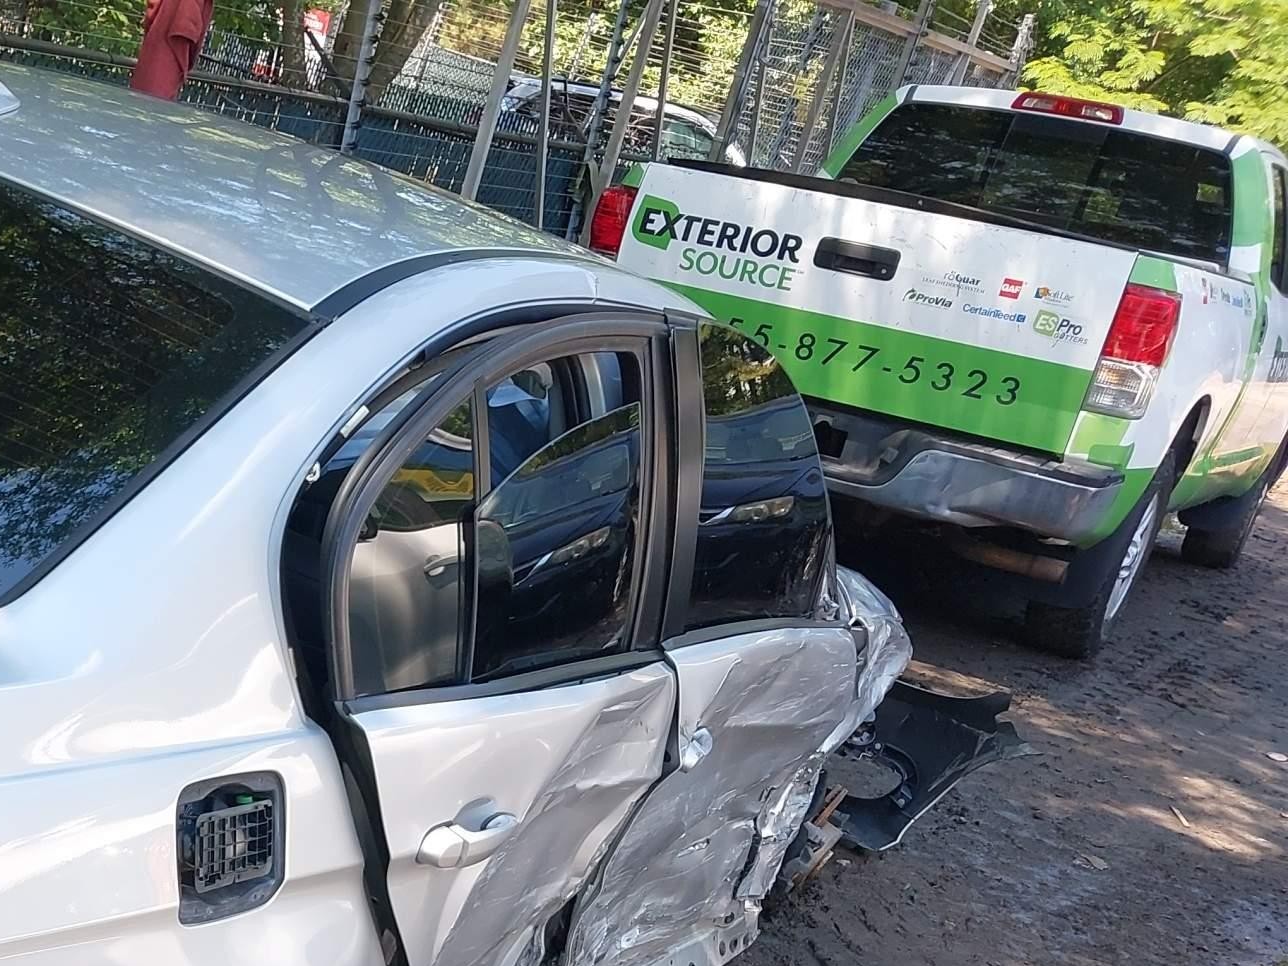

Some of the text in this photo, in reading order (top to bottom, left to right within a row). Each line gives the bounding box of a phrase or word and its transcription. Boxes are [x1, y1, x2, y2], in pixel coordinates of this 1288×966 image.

[639, 207, 803, 263] EXTERIOR
[679, 248, 796, 291] SOURCE
[1001, 283, 1022, 295] GAF
[916, 293, 953, 309] ProVia
[962, 303, 1016, 322] CertainTeed
[1035, 314, 1082, 336] ES Pro
[729, 318, 1021, 405] 5-877-5323
